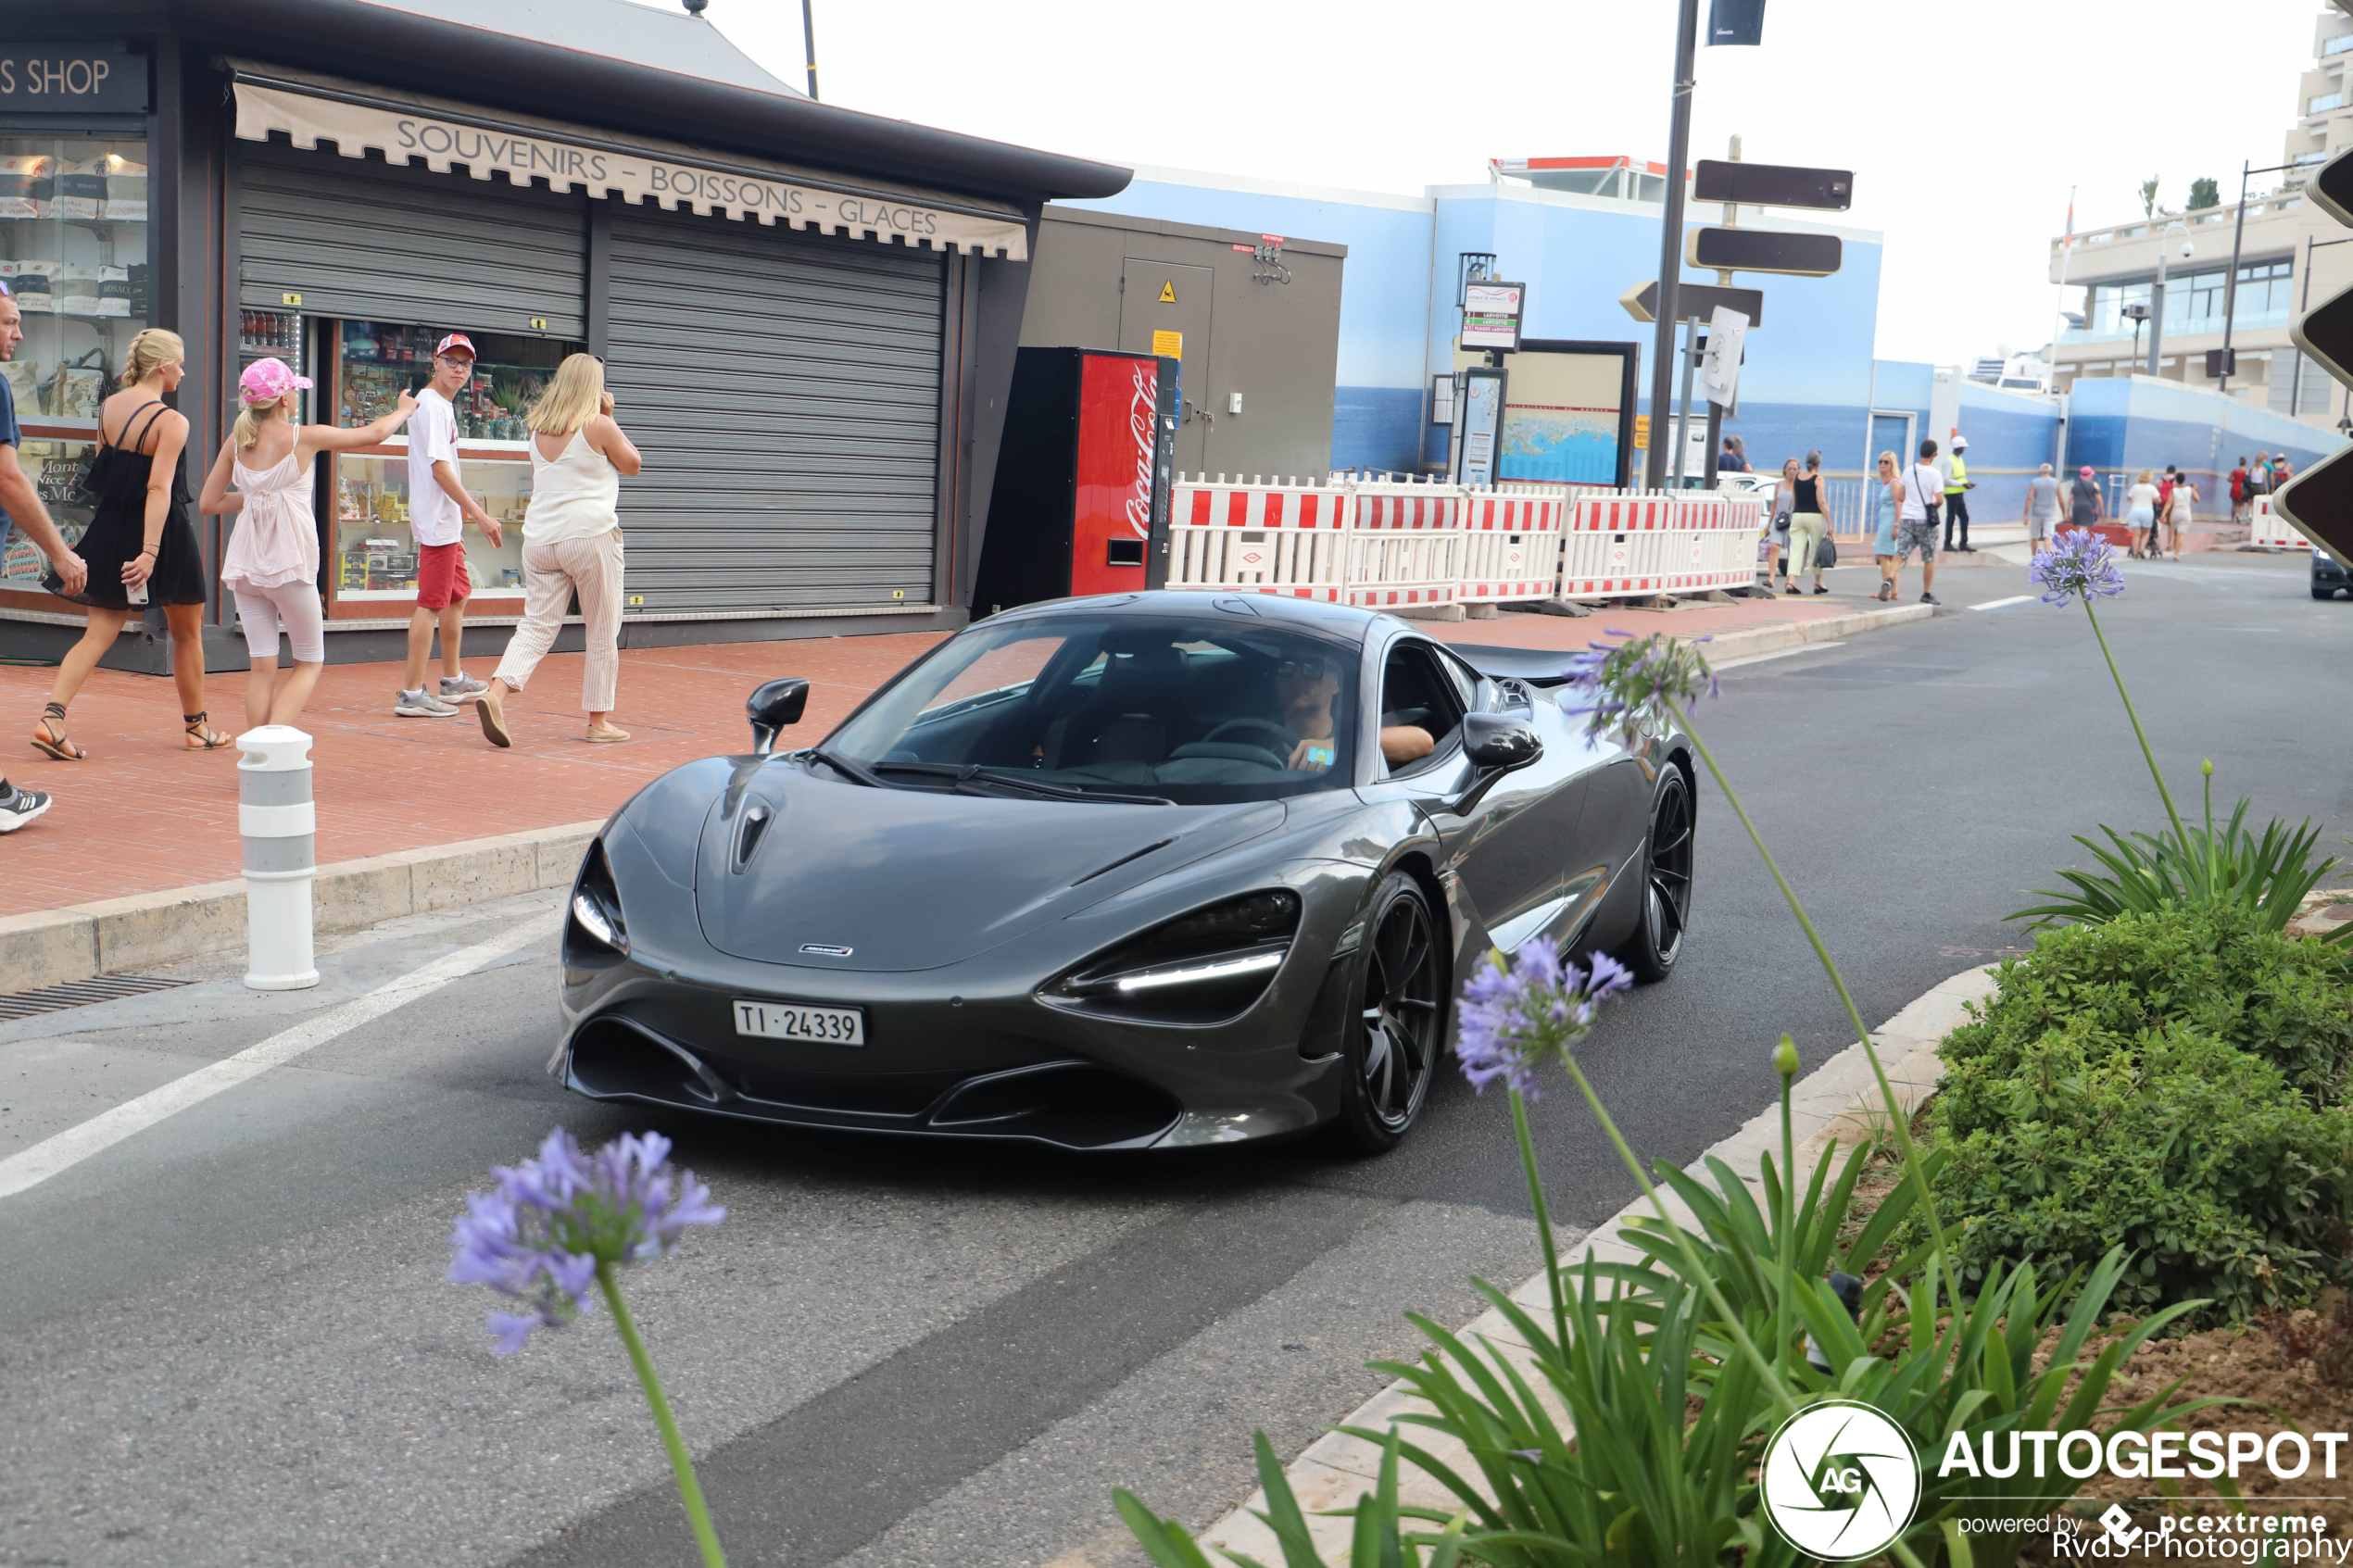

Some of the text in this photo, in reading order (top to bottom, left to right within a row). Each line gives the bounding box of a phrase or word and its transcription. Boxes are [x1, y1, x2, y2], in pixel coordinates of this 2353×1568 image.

[27, 59, 109, 94] SHOP
[397, 119, 607, 181] SOUVENIRS
[650, 165, 803, 214] BOISSONS
[837, 199, 937, 234] GLACES
[784, 1010, 855, 1041] 24339
